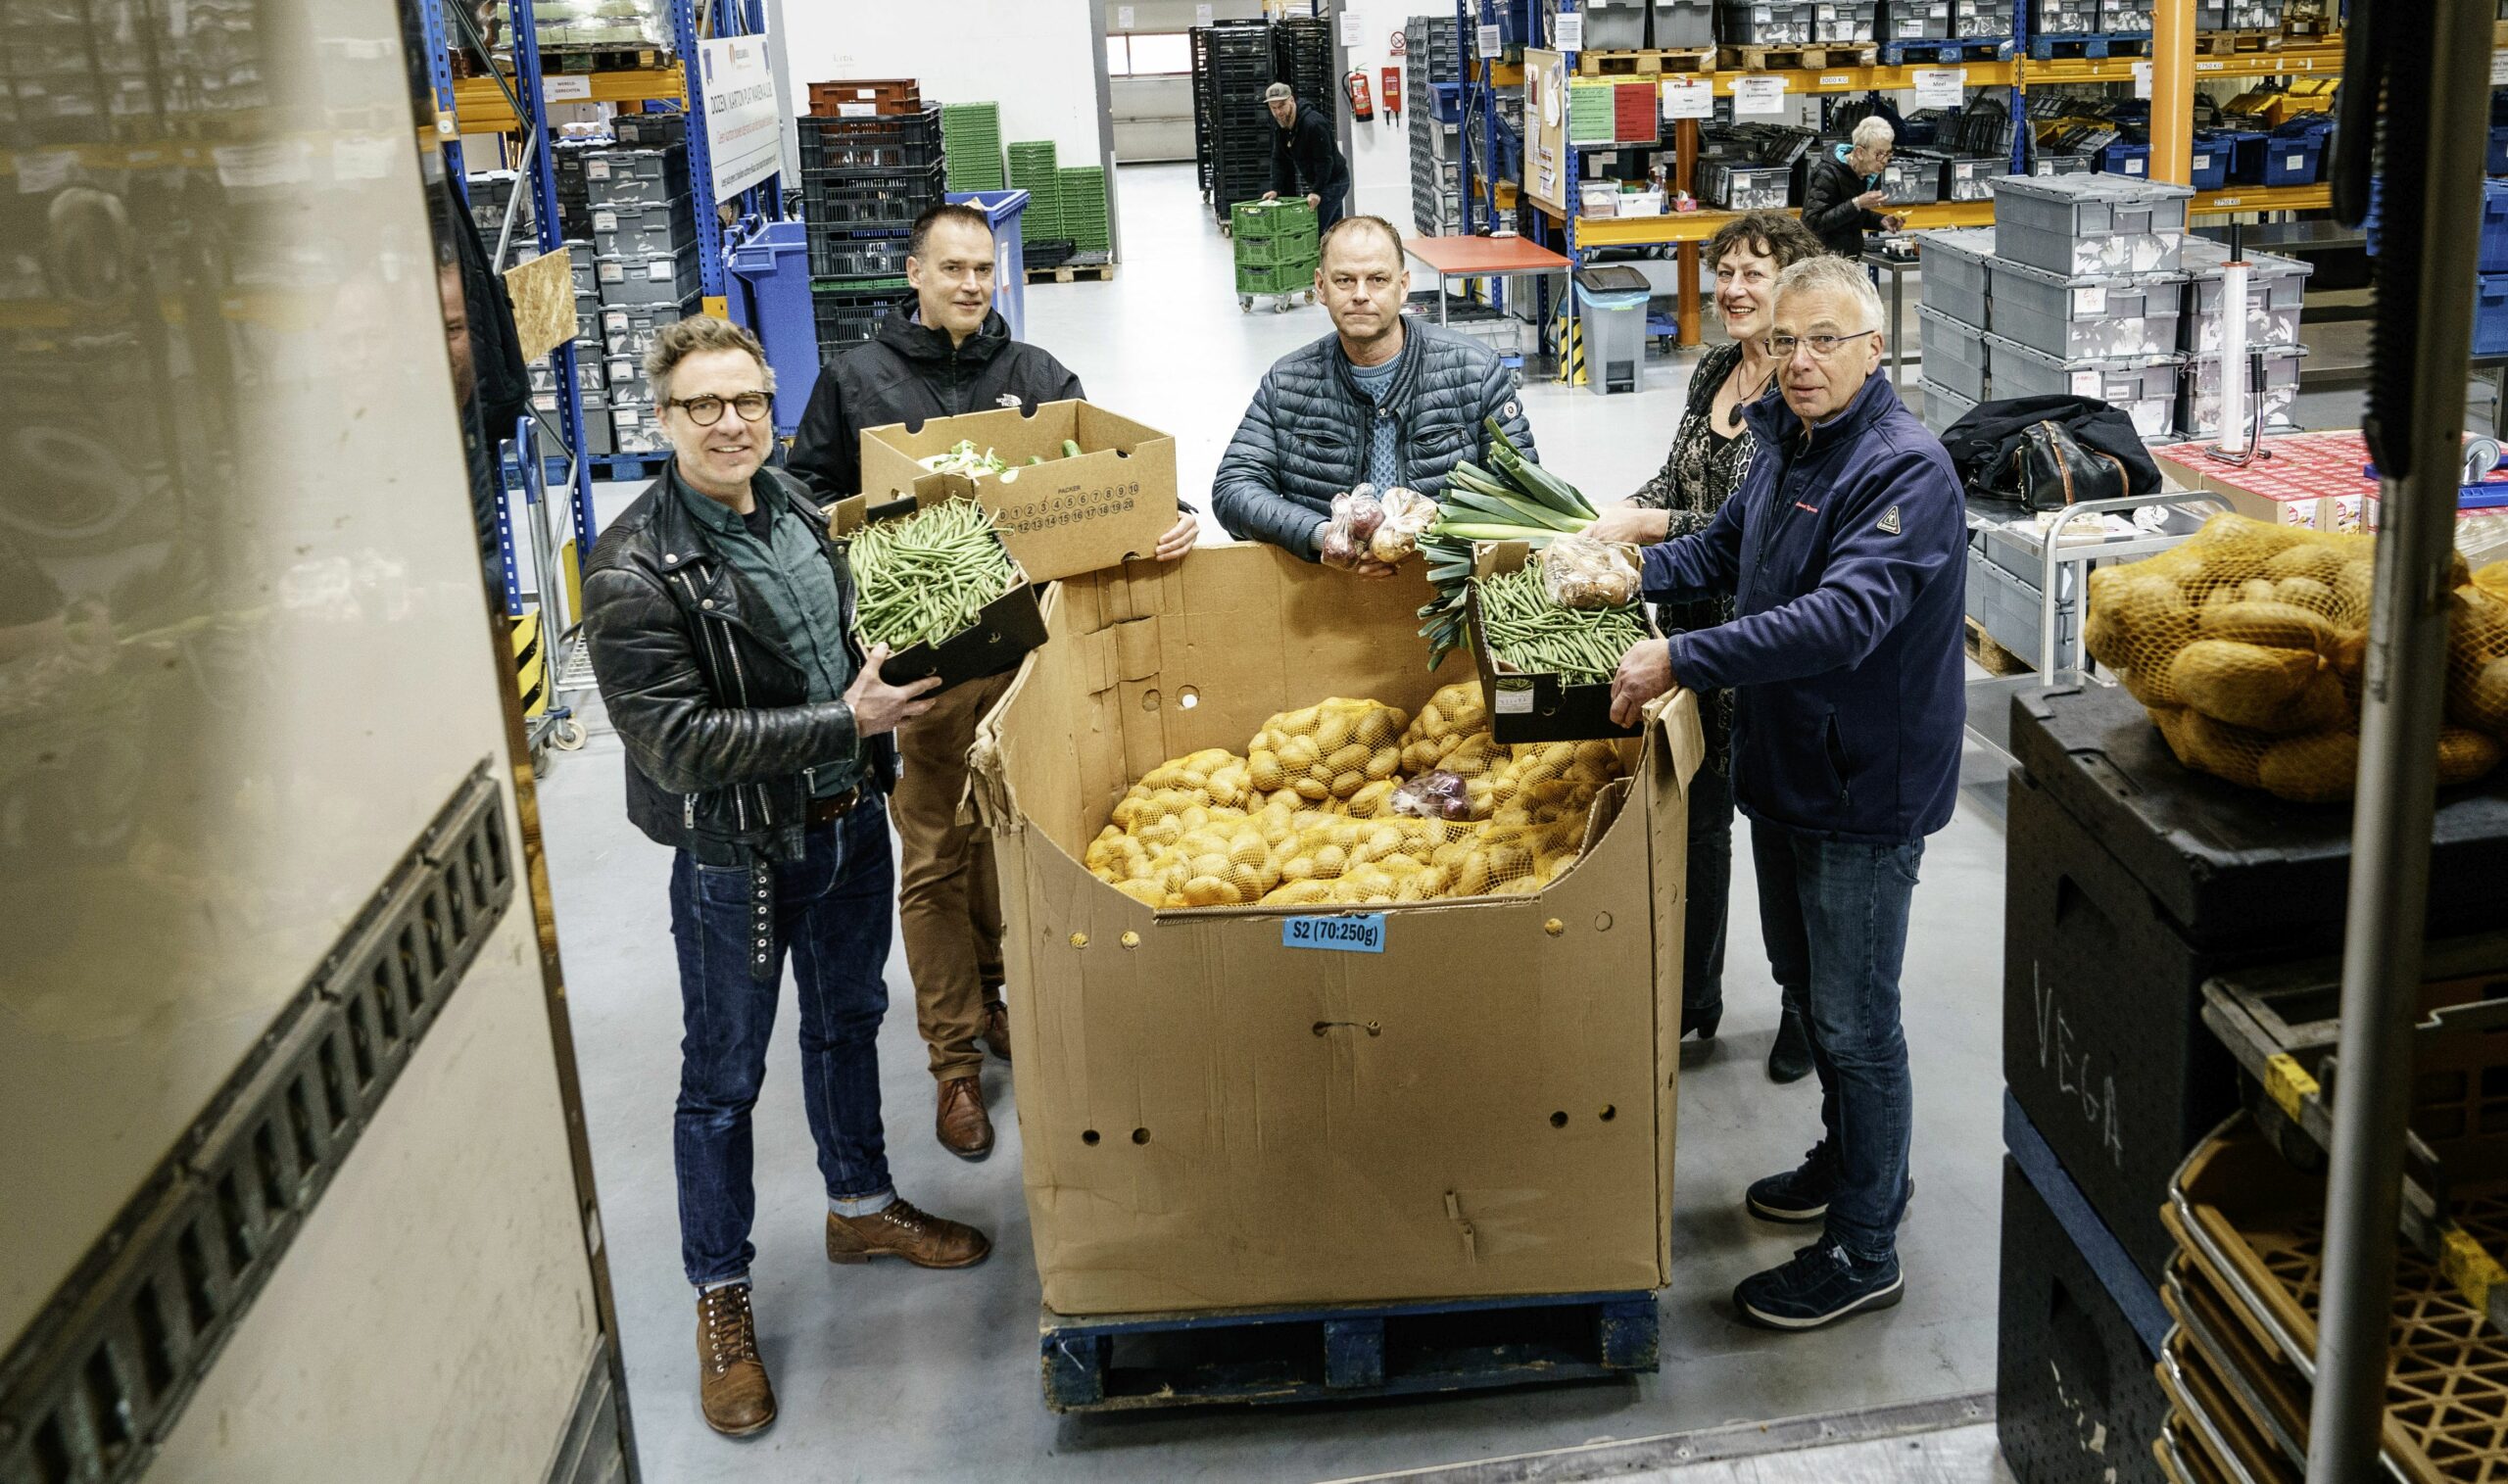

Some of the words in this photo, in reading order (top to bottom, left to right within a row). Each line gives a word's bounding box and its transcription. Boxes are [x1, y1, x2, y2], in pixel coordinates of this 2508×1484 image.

[1058, 485, 1081, 494] PACKER
[1293, 921, 1310, 939] S2
[1314, 921, 1377, 947] (70:250g)
[2035, 959, 2123, 1166] VEGA
